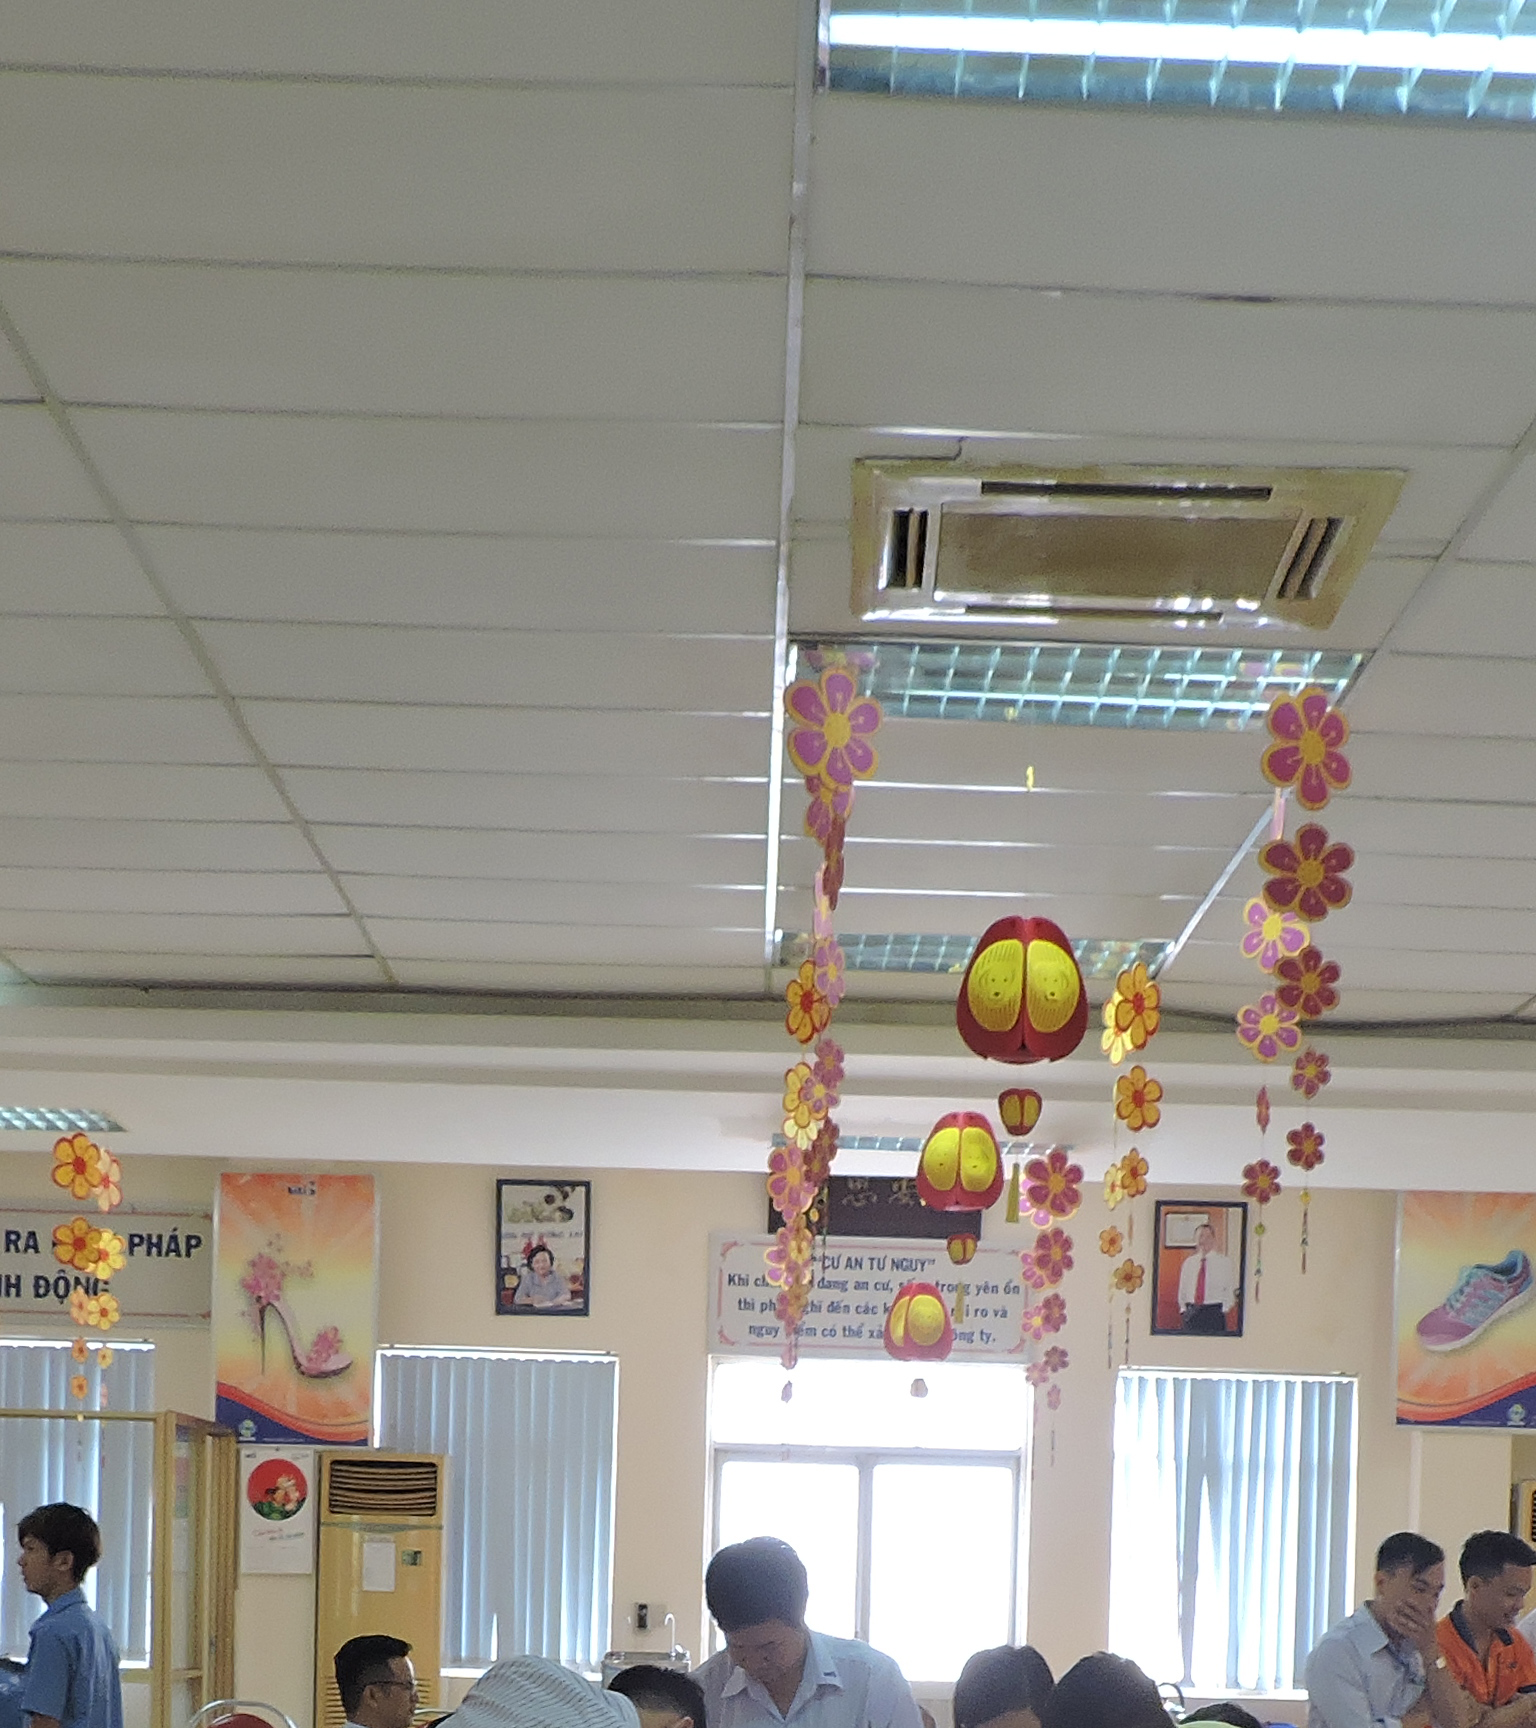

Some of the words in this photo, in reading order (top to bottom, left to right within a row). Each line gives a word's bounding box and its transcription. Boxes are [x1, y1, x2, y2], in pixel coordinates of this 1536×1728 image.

[4, 1229, 41, 1254] RA
[128, 1226, 203, 1259] PHÁP
[728, 1273, 750, 1287] Khi
